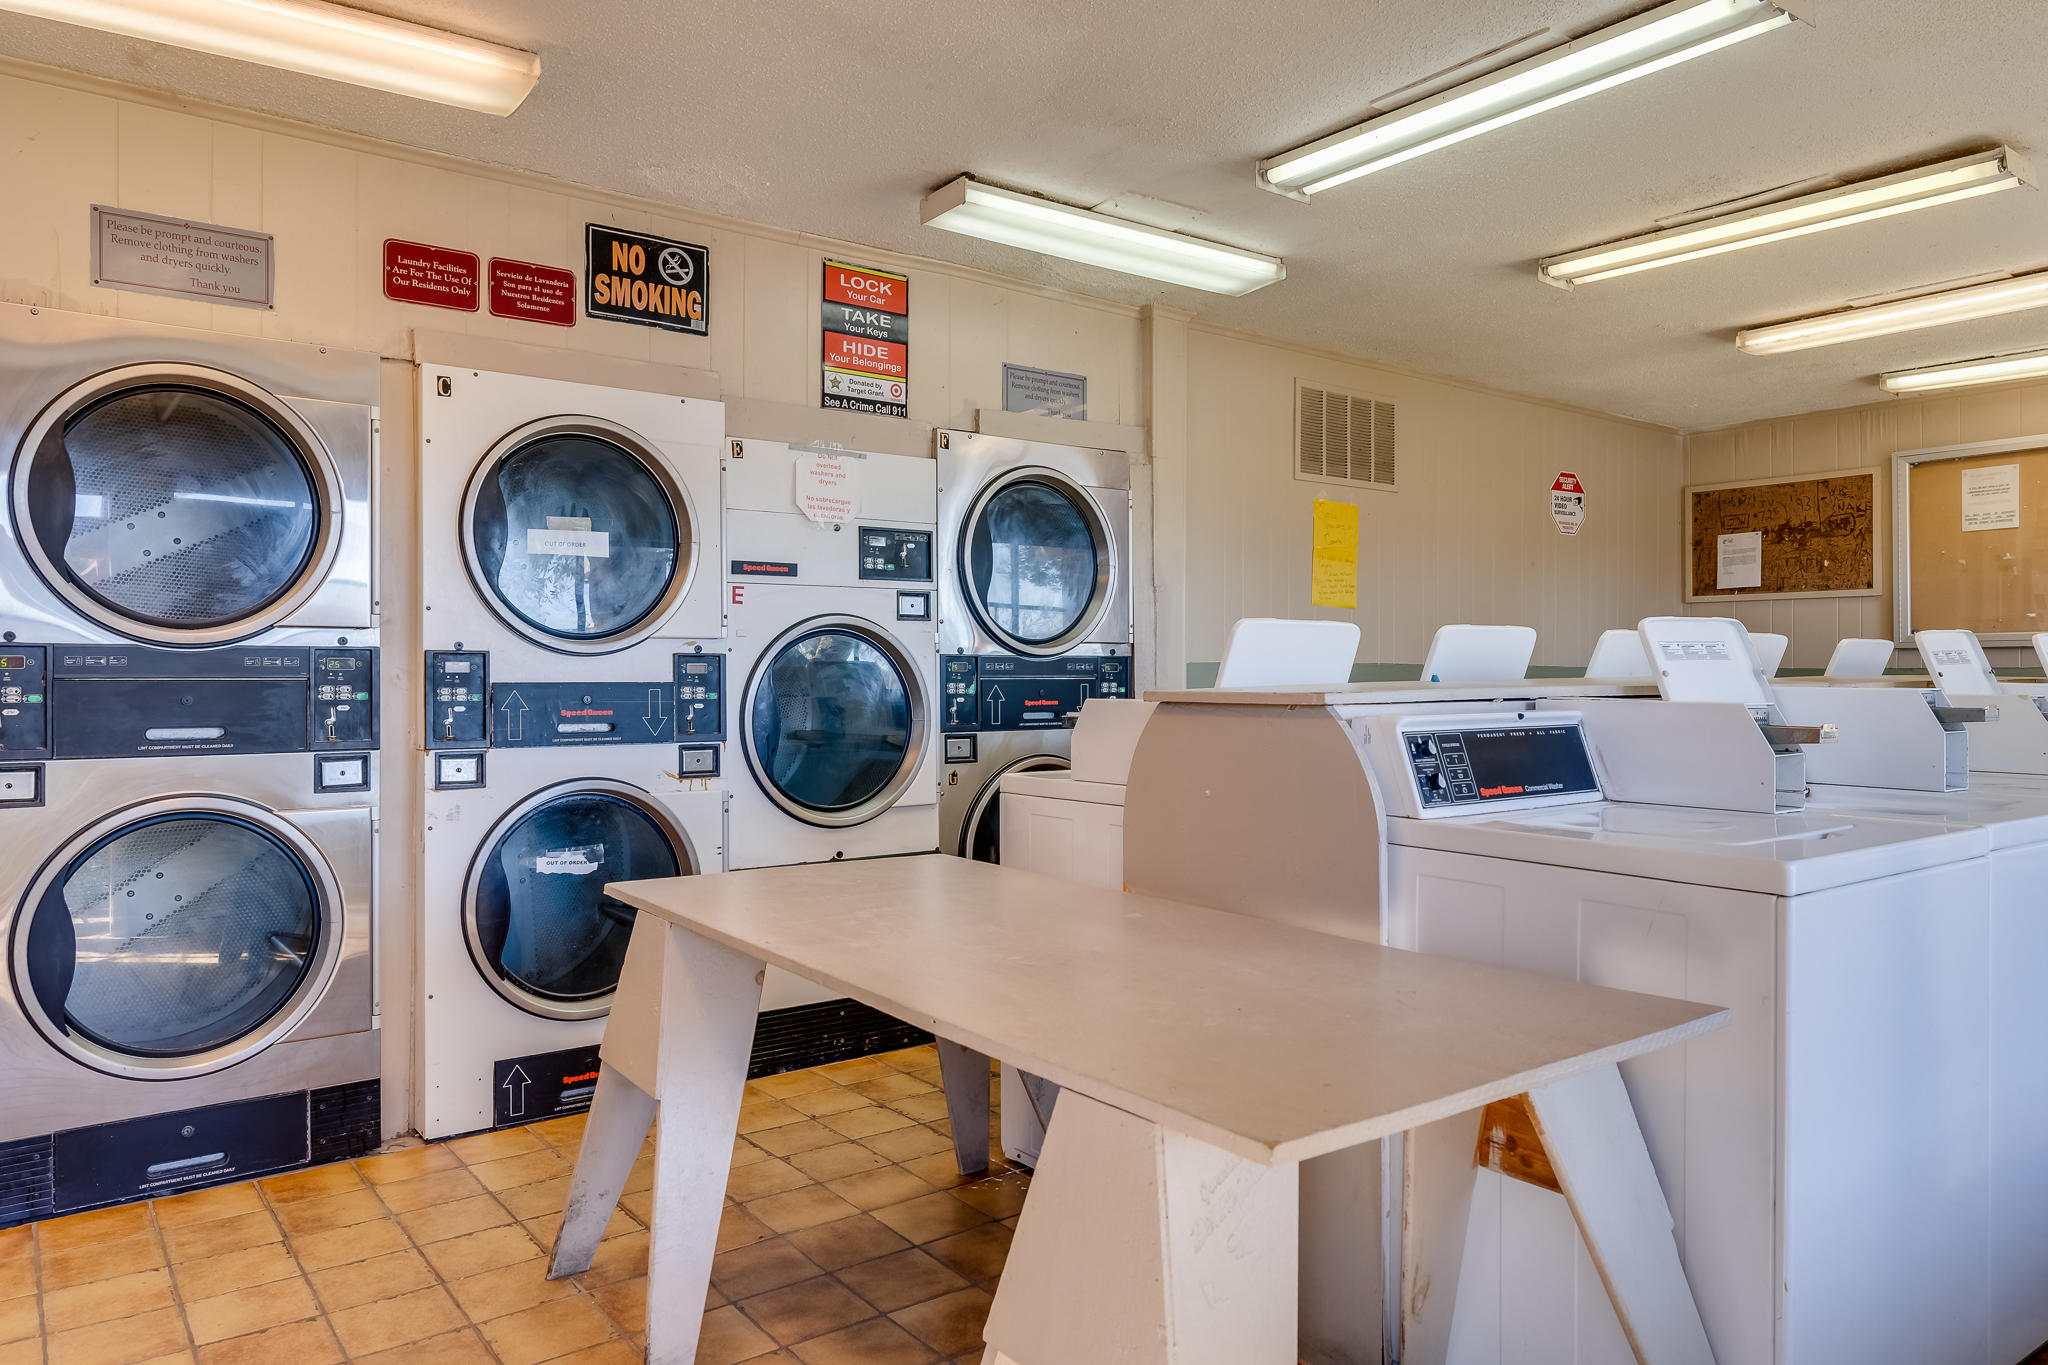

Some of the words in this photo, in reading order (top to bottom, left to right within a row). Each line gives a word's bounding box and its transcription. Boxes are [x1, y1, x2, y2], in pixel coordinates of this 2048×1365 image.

[107, 219, 138, 234] Please
[141, 225, 152, 235] be
[155, 230, 191, 244] prompt
[194, 236, 211, 246] and
[111, 234, 151, 248] Remove
[154, 241, 193, 257] clothing
[196, 247, 218, 259] from
[221, 252, 259, 266] washers
[612, 241, 645, 275] NO
[140, 253, 158, 262] and
[162, 256, 193, 269] dryers
[196, 261, 231, 274] quickly.
[398, 256, 431, 270] Laundry
[433, 261, 467, 274] Facilities
[392, 265, 408, 275] Are
[410, 268, 424, 278] For
[426, 271, 442, 280] The
[444, 274, 460, 283] Use
[461, 276, 472, 286] Of
[496, 270, 523, 280] Servicio
[190, 277, 220, 291] Thank
[223, 284, 240, 294] you
[393, 277, 410, 287] Our
[412, 279, 450, 292] Residents
[451, 286, 471, 296] Only
[503, 280, 516, 289] Son
[518, 283, 532, 292] para
[840, 274, 892, 296] LOCK
[501, 289, 530, 299] Nuestros
[532, 294, 565, 306] Residentes
[594, 273, 702, 320] SMOKING
[847, 290, 867, 301] Your
[870, 295, 886, 305] Car
[516, 302, 550, 312] Solamente
[841, 307, 891, 328] TAKE
[844, 322, 865, 334] Your
[867, 326, 888, 338] Keys
[843, 340, 889, 360] HIDE
[830, 352, 850, 363] Your
[853, 356, 901, 372] Belongings
[438, 377, 450, 396] C
[847, 386, 866, 394] Target
[849, 379, 874, 388] Donated
[824, 397, 840, 407] See
[842, 399, 848, 408] A
[850, 400, 874, 412] Crime
[876, 404, 890, 414] Call
[892, 407, 906, 416] 911
[940, 433, 949, 448] F
[744, 564, 765, 572] Speed
[732, 586, 744, 604] E
[328, 660, 340, 668] 25
[561, 709, 586, 717] Speed
[563, 1072, 590, 1084] Speed
[150, 1177, 183, 1187] COMPARTMENT
